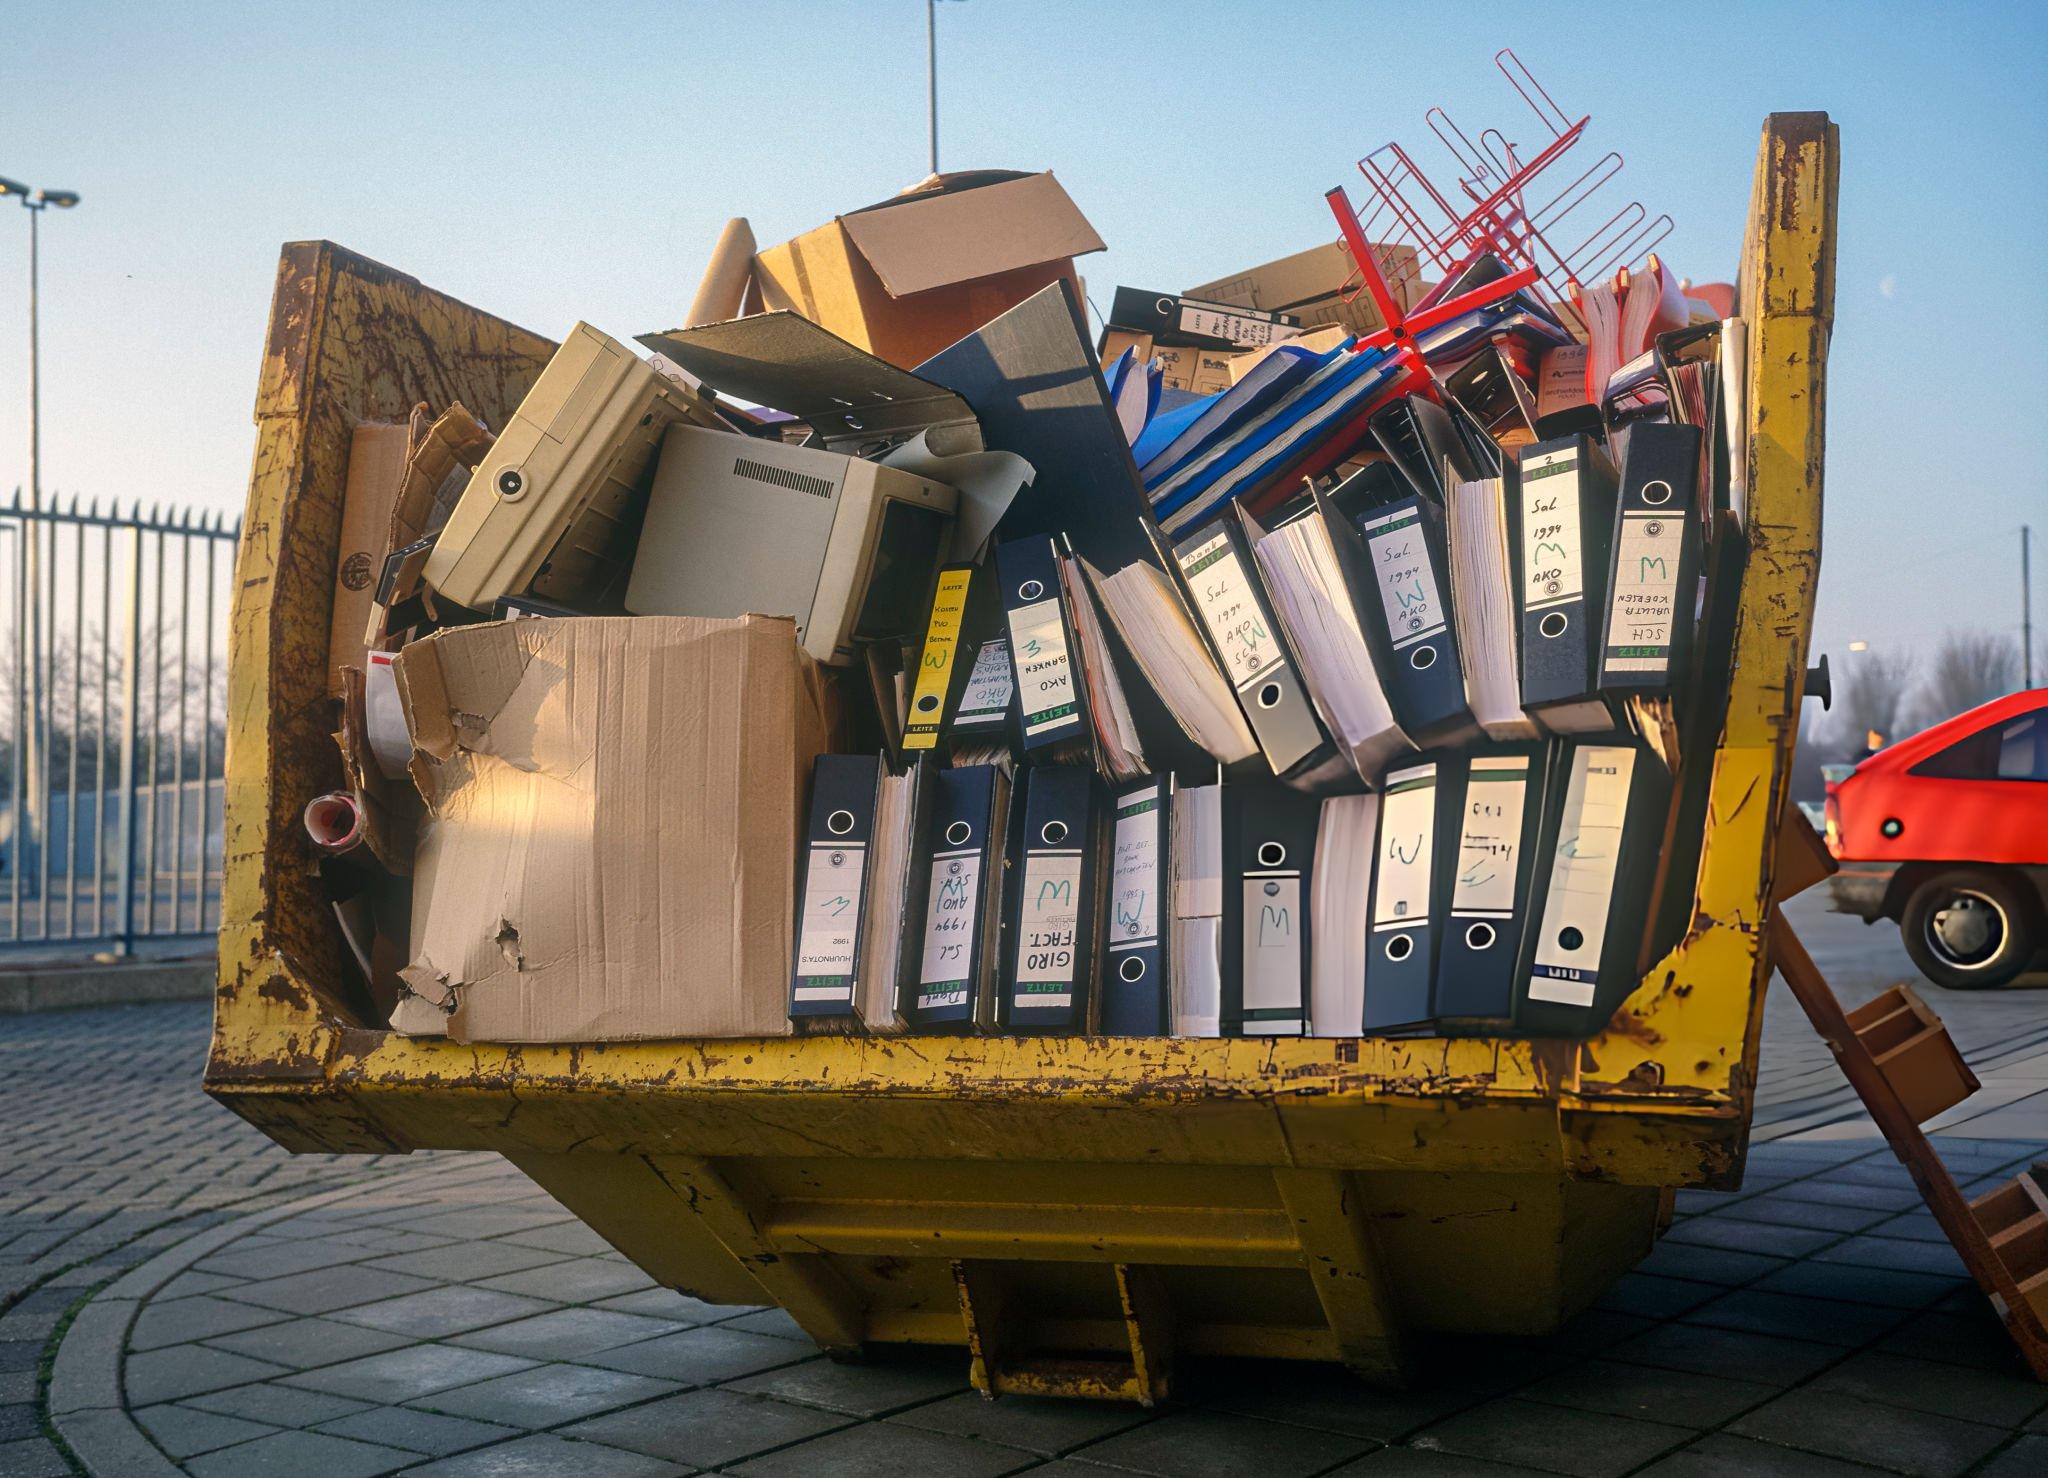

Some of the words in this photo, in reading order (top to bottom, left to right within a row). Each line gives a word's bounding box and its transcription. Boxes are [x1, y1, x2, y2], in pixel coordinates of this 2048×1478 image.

[1544, 455, 1554, 465] 2
[1532, 462, 1569, 480] LEITZ
[1376, 518, 1409, 536] LEITZ
[1533, 524, 1562, 540] 1994
[1389, 566, 1420, 583] 1994
[1532, 568, 1562, 583] AKO
[1398, 603, 1427, 621] AKO
[1625, 607, 1671, 616] VALUTA
[1226, 620, 1251, 644] AKO
[1632, 628, 1665, 641] SCH
[1618, 647, 1661, 657] LEITZ
[1025, 655, 1067, 674] BANKEN
[1040, 675, 1067, 691] AKO
[976, 687, 1007, 700] AKO
[1031, 705, 1072, 724] LEITZ
[943, 896, 968, 910] AKO
[934, 918, 967, 932] 1994
[1030, 930, 1072, 947] FACT.
[802, 955, 852, 963] HUURNOTA'S
[1027, 951, 1071, 970] GIRO
[807, 977, 842, 987] LEITZ
[927, 981, 961, 993] LEITZ
[1026, 983, 1065, 992] LEITZ
